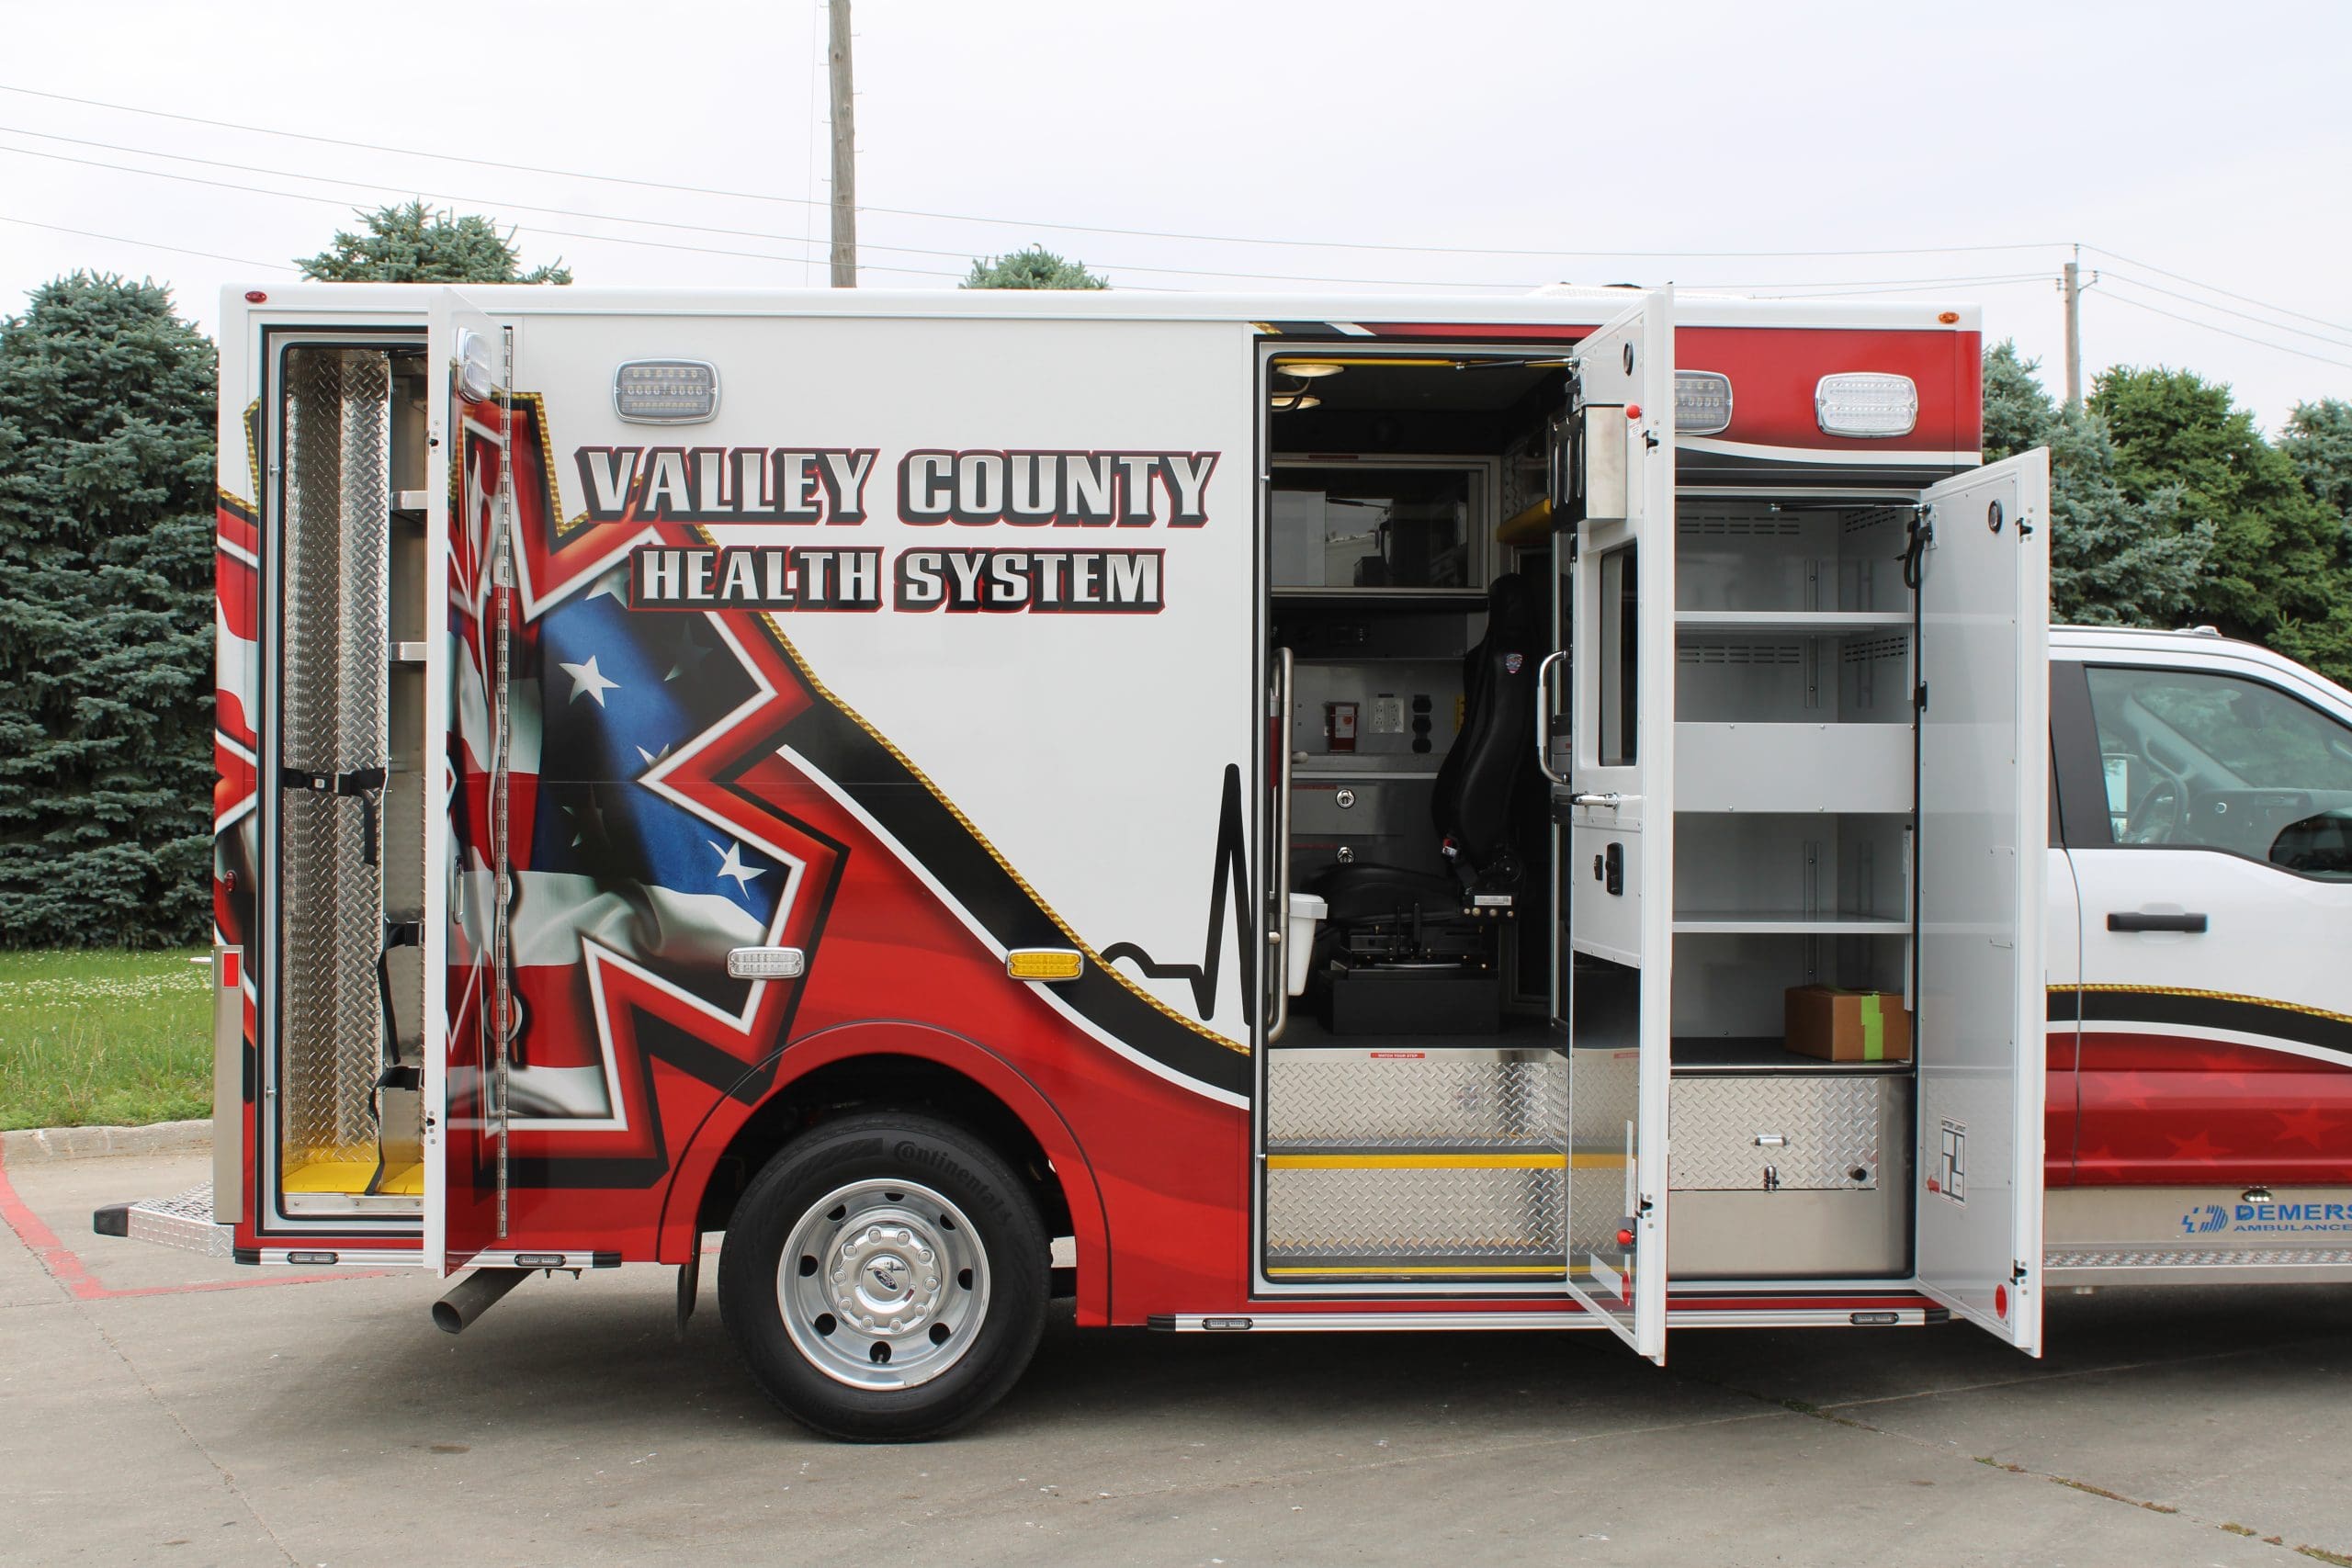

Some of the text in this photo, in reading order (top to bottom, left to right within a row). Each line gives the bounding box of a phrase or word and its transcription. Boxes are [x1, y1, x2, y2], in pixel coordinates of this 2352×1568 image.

[574, 446, 1221, 527] VALLEY COUNTY
[630, 546, 1165, 614] HEALTH SYSTEM
[894, 1141, 1005, 1213] Continental
